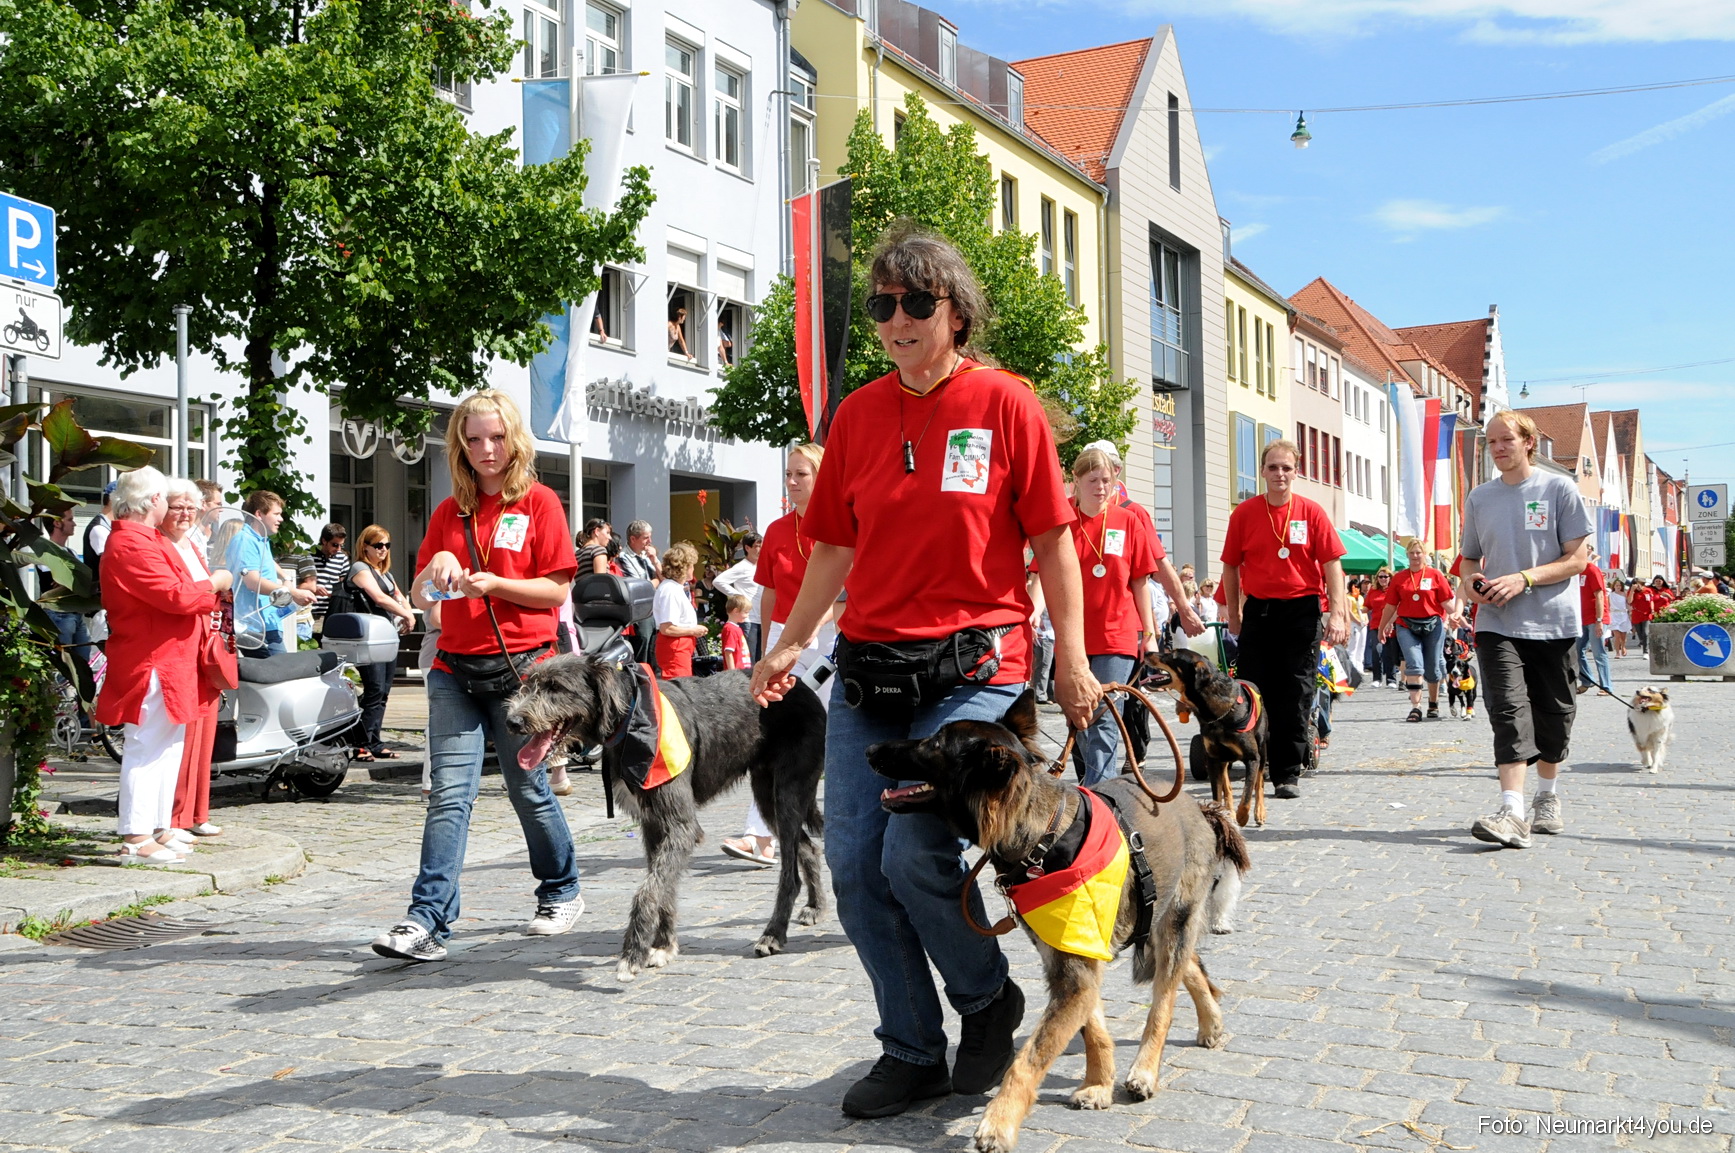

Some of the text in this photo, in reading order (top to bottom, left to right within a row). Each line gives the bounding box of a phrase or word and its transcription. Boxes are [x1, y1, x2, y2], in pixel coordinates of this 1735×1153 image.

[8, 206, 42, 269] P
[15, 293, 37, 308] nur
[586, 376, 720, 427] aiffeisenb
[882, 686, 902, 694] DEKRA
